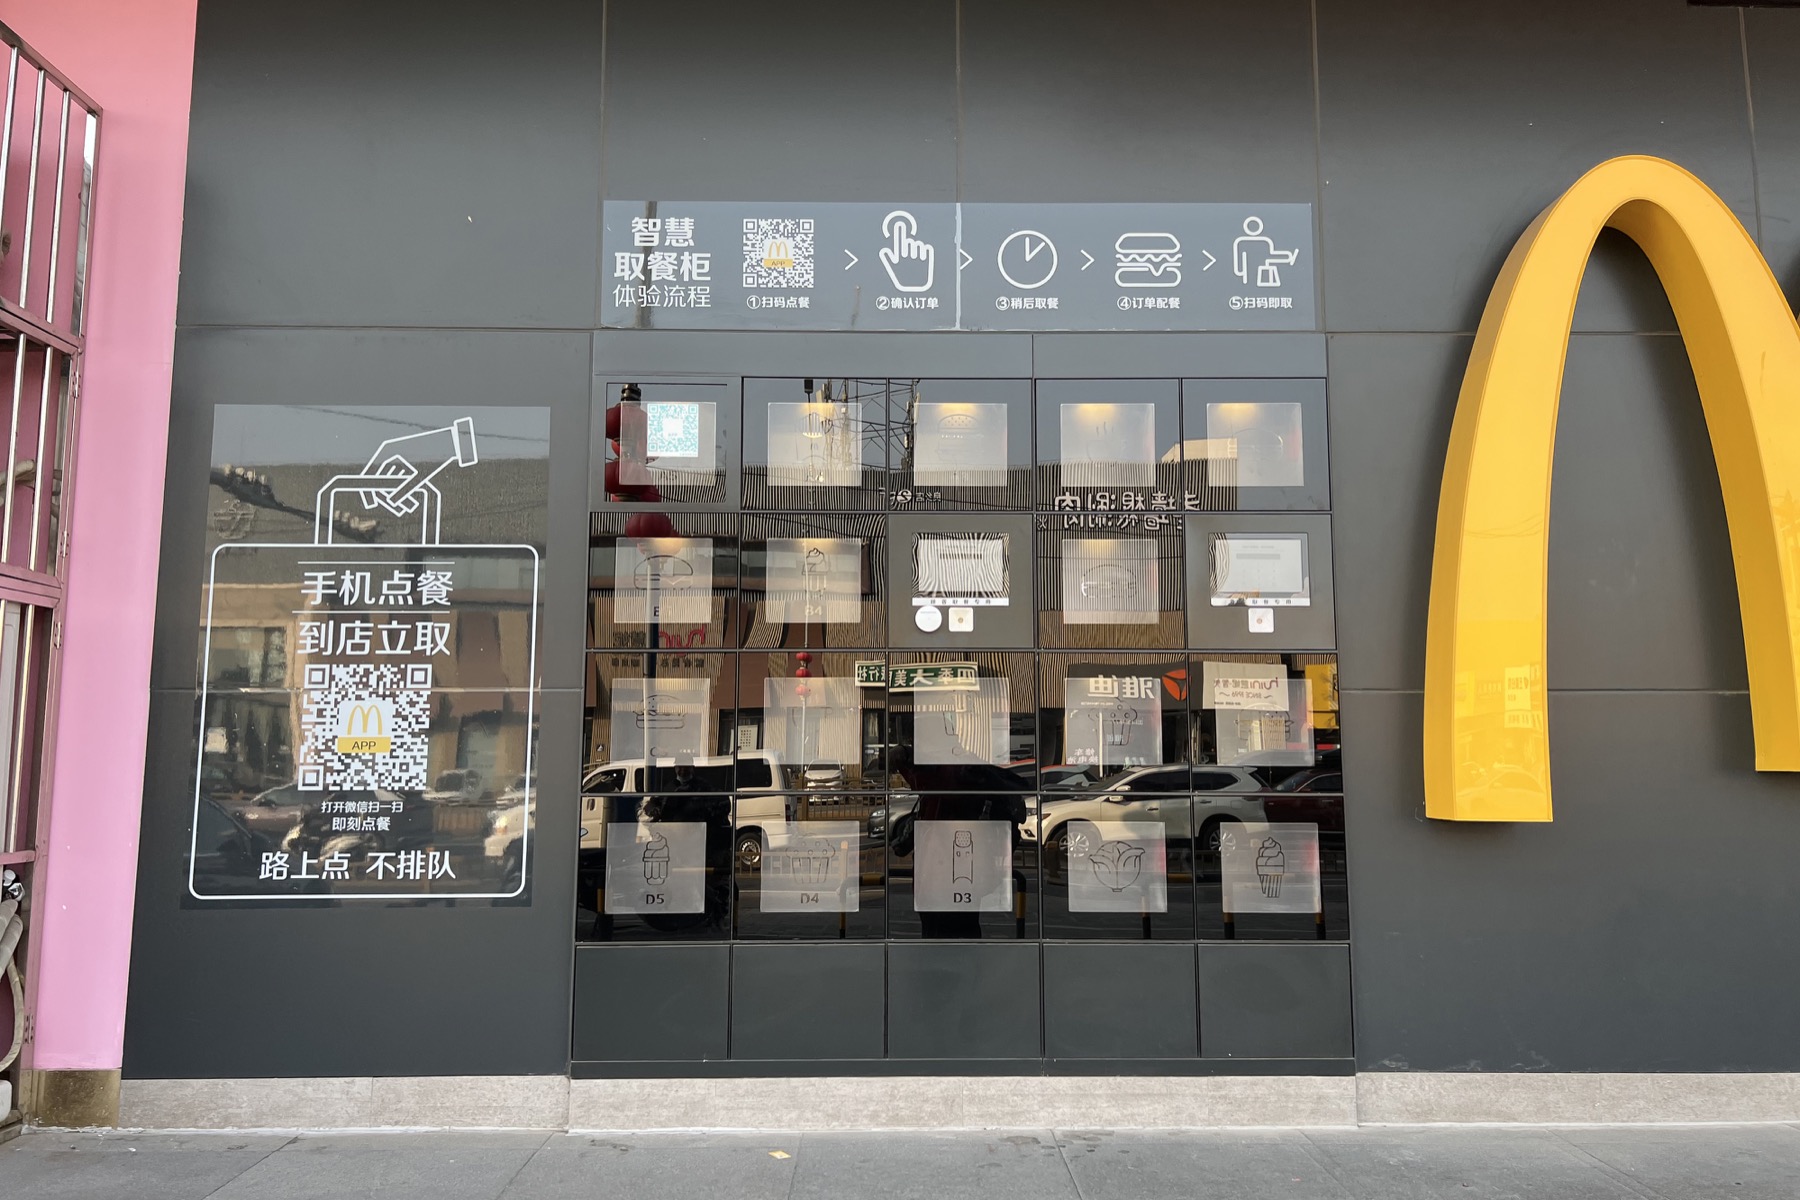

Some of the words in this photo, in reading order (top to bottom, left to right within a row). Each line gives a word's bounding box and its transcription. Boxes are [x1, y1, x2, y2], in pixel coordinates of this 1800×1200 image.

[631, 216, 695, 247] 智慧
[613, 252, 711, 282] 取餐柜
[612, 284, 711, 308] 体验流程
[301, 570, 454, 606] 手机点餐
[297, 620, 451, 656] 到店立取
[352, 741, 376, 750] APP
[321, 801, 404, 814] 打开微信扫一扫
[332, 816, 391, 831] 即刻点餐
[259, 851, 350, 880] 路上点
[365, 850, 456, 880] 不排队
[645, 893, 665, 905] D5
[800, 892, 819, 904] D4
[953, 892, 972, 904] D3
